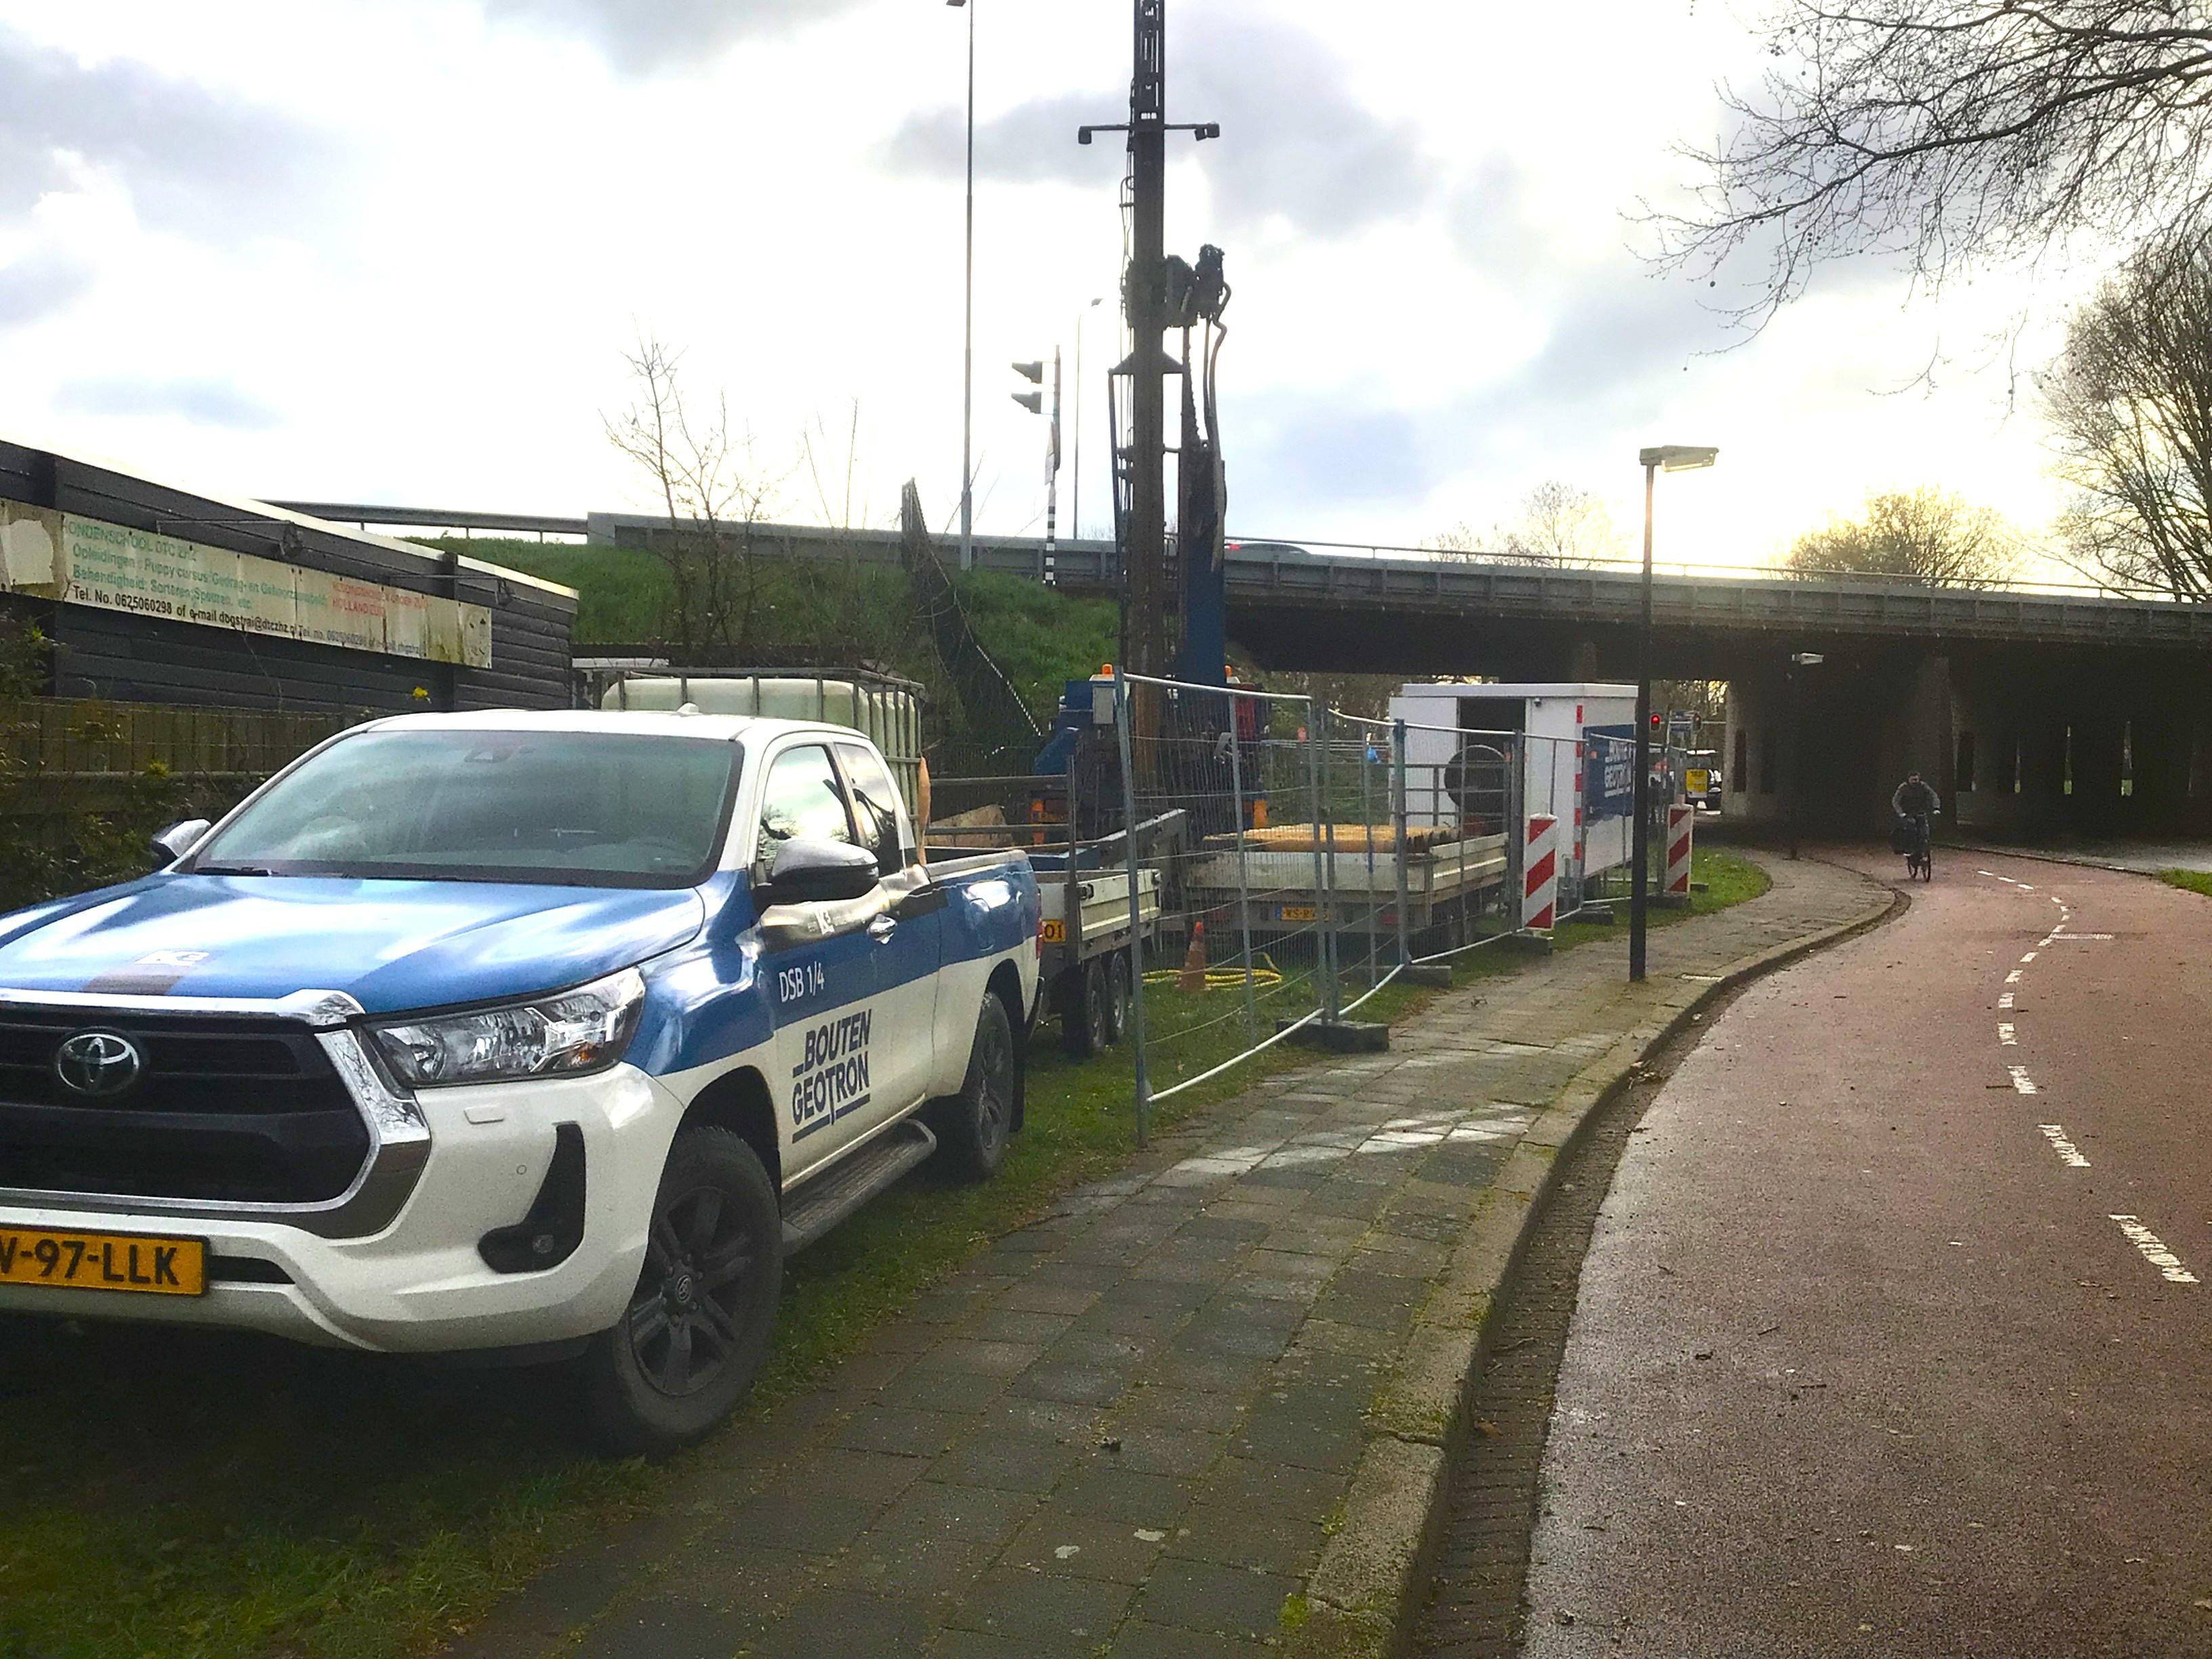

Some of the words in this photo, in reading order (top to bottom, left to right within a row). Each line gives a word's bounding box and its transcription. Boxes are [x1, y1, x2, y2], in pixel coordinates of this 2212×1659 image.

[144, 558, 175, 579] Puppy
[73, 585, 91, 602] Tel.
[95, 589, 112, 605] No.
[115, 592, 172, 615] 0625060298
[176, 605, 186, 617] of
[779, 967, 804, 1003] DSB
[806, 960, 825, 997] 1/4
[804, 1008, 872, 1072] BOUTEN
[792, 1050, 870, 1126] GEOTRON
